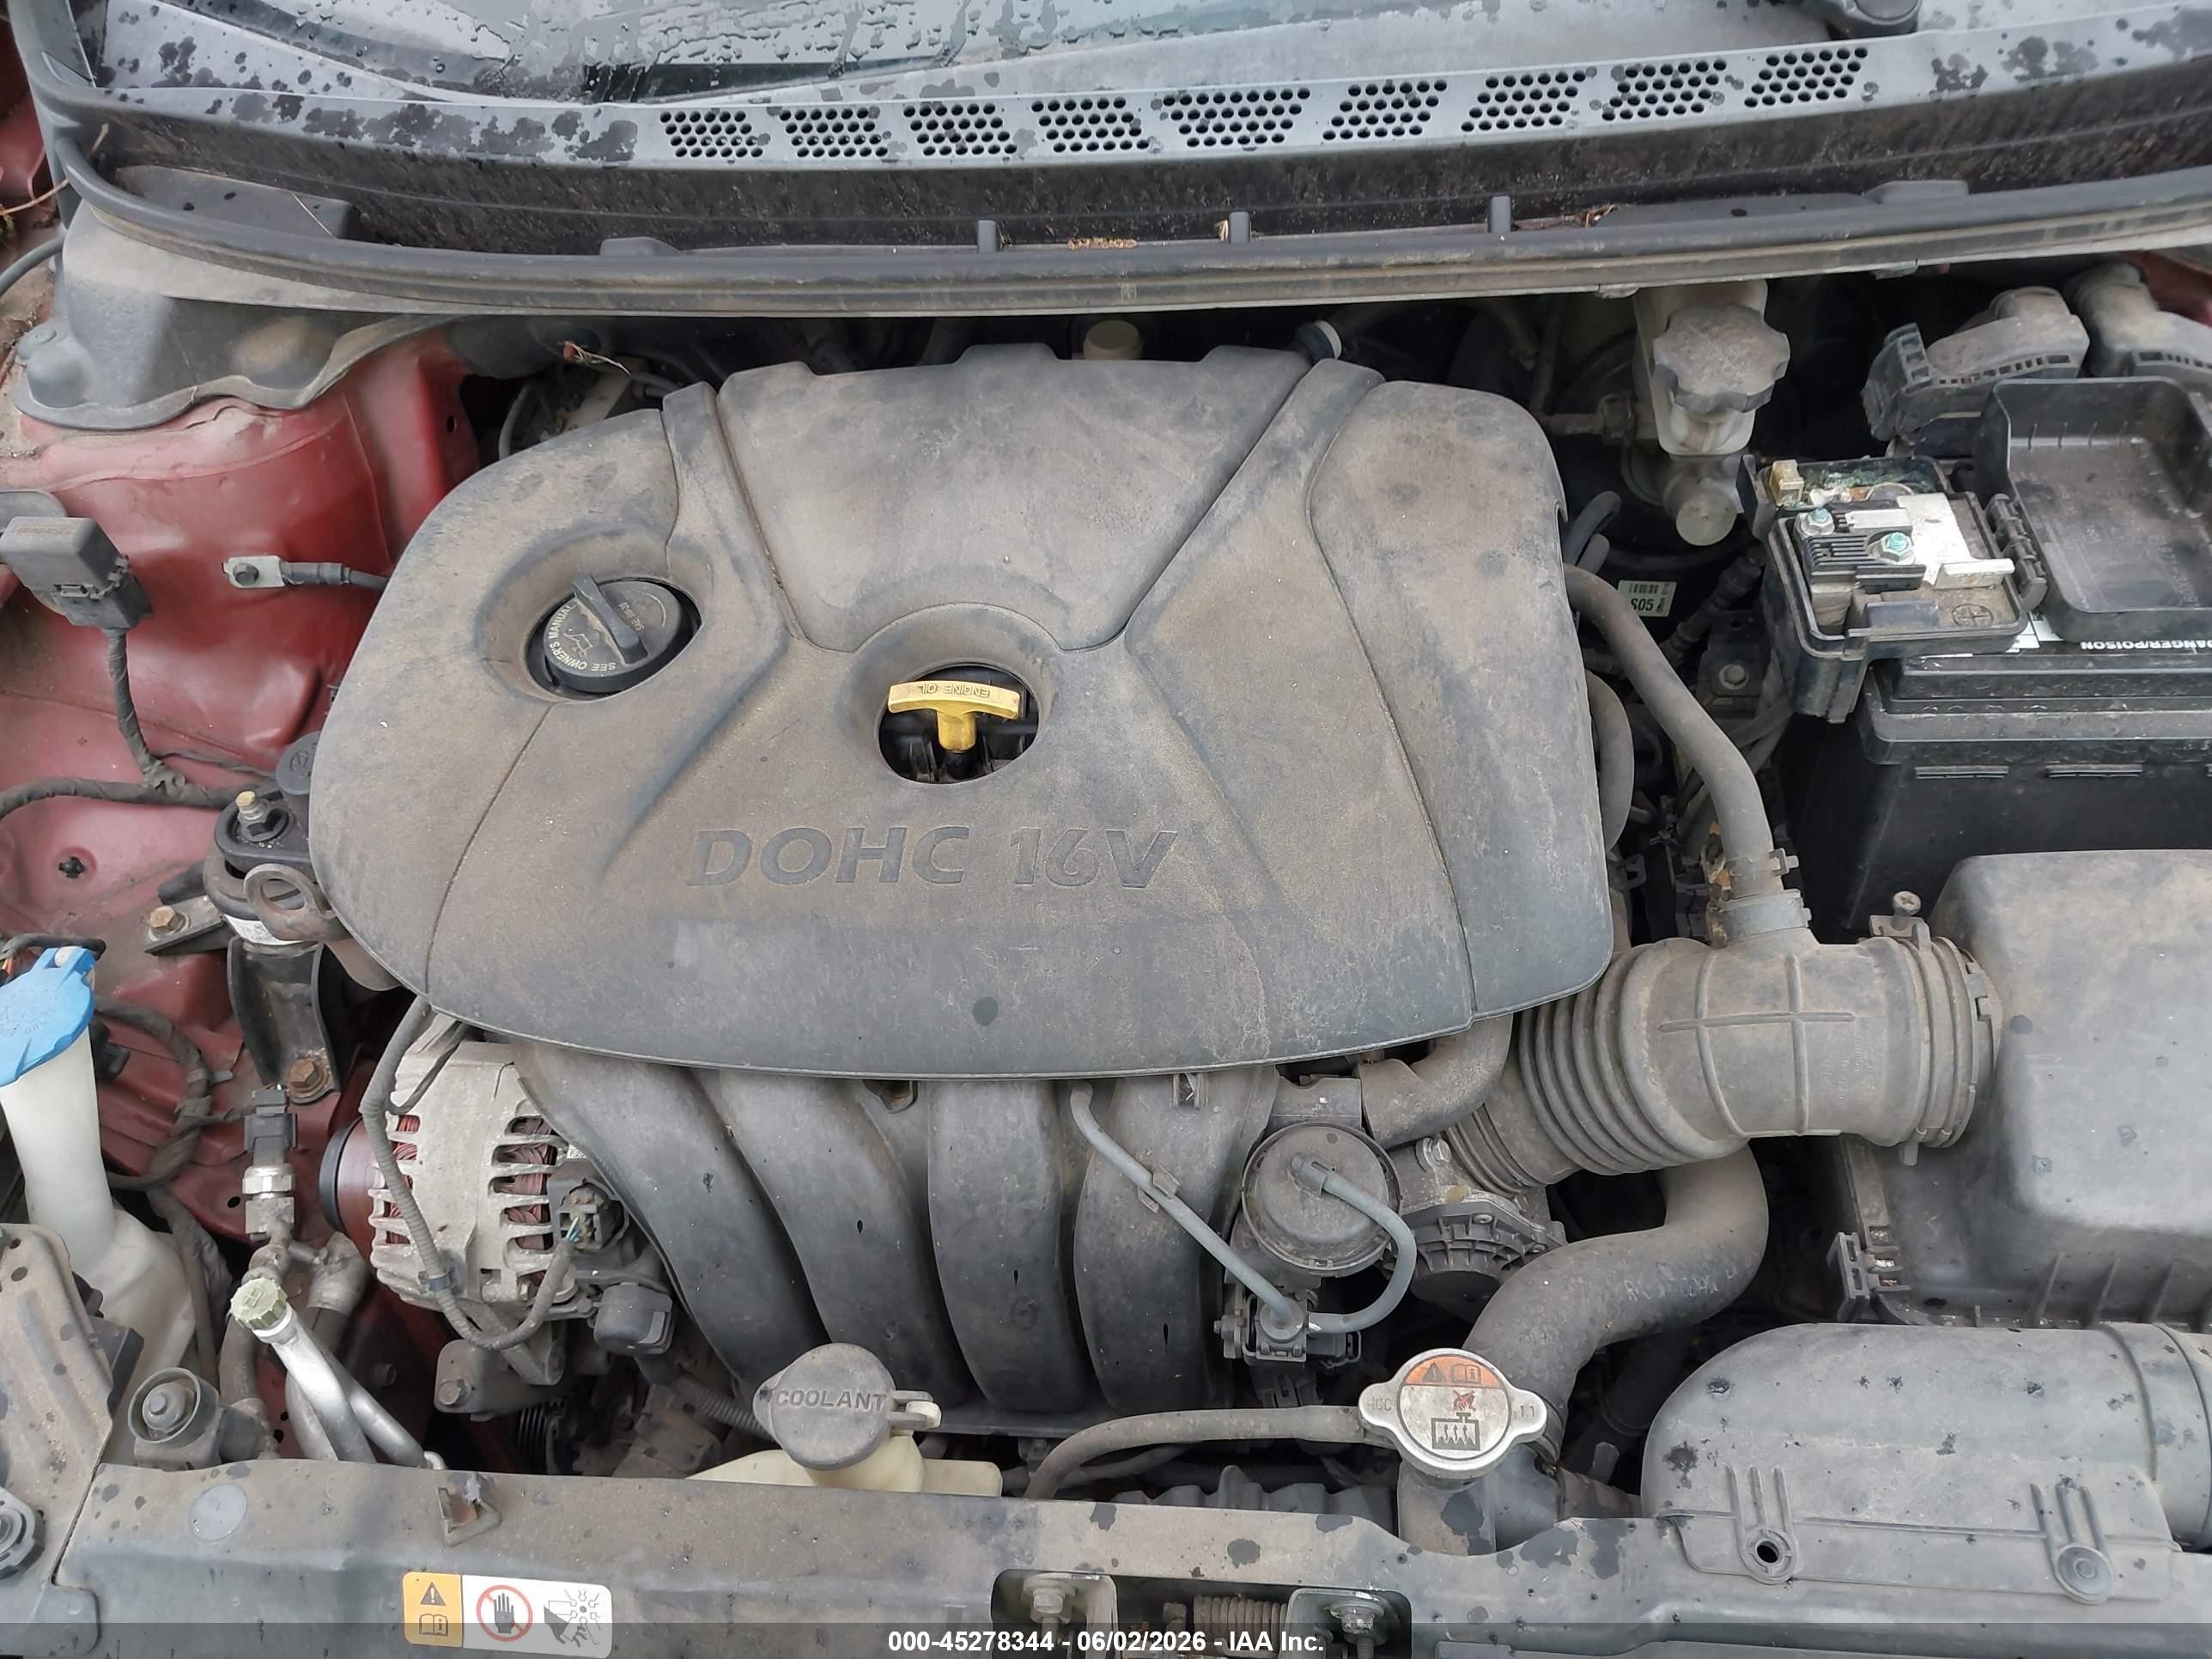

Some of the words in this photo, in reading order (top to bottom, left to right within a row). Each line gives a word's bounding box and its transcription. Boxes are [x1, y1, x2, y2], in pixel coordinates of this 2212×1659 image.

[549, 603, 576, 640] MANUAL
[549, 641, 588, 671] OWNER'S
[591, 662, 617, 672] SEE
[917, 684, 939, 695] OIL
[944, 684, 990, 699] ENGINE
[686, 825, 969, 885] DOHC
[1010, 826, 1178, 889] 16V
[774, 1389, 888, 1413] COOLANT
